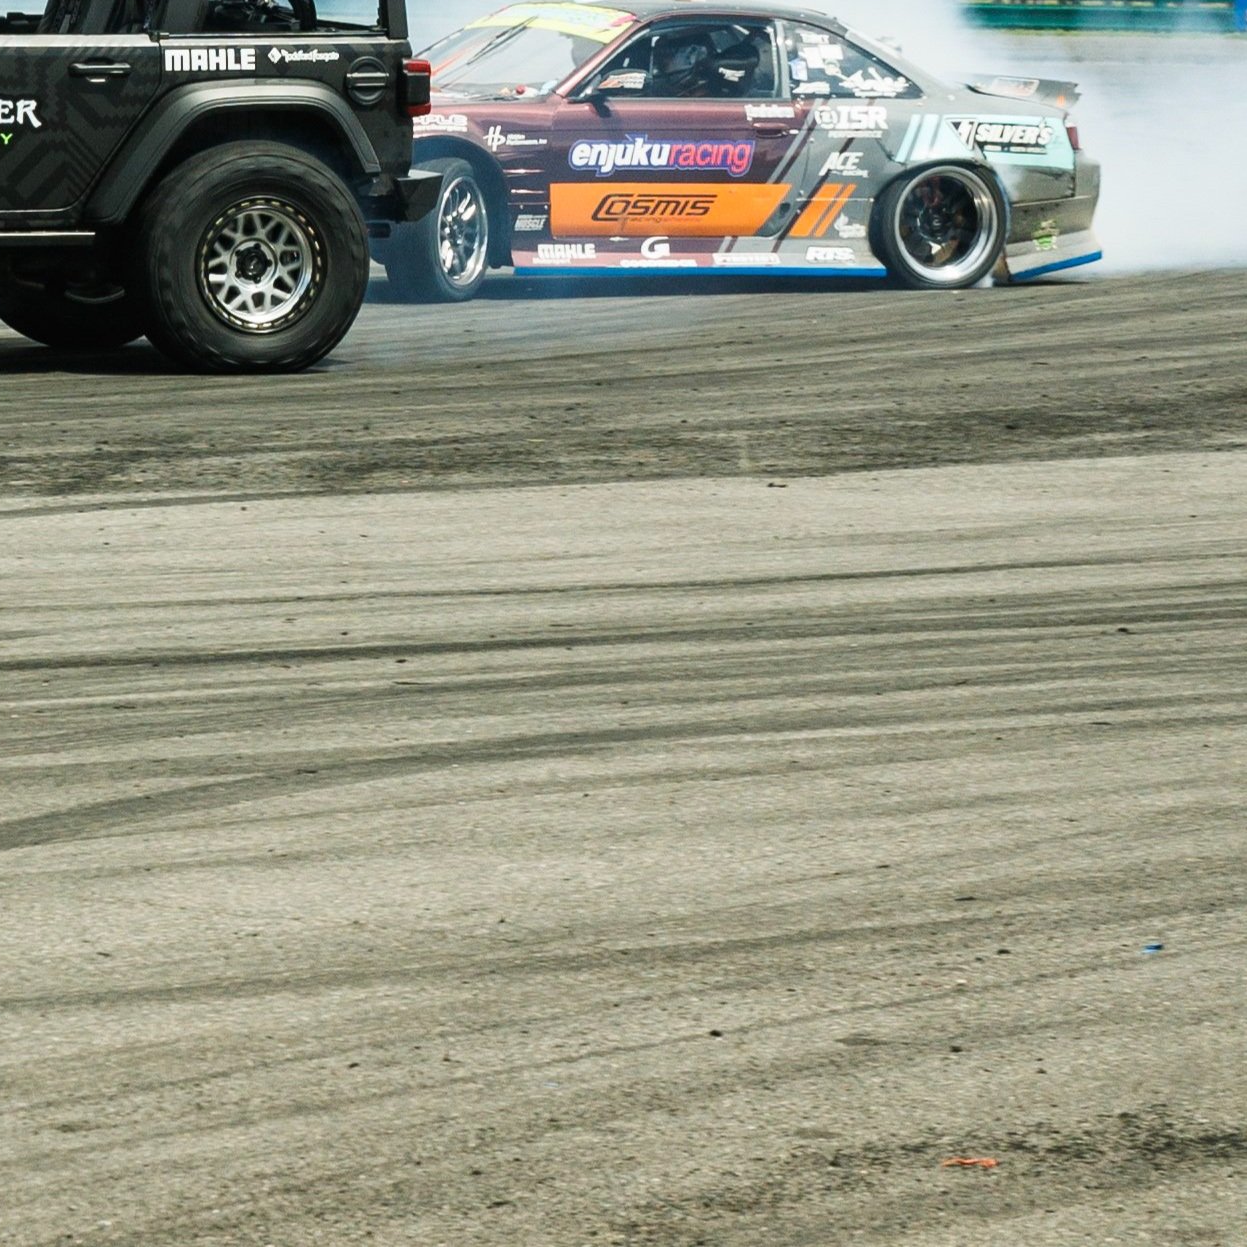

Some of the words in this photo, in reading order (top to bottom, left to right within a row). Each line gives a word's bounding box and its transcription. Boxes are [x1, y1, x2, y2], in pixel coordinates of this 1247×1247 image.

[165, 48, 256, 72] MAHLE
[837, 106, 889, 129] ISR
[818, 152, 864, 176] ACE
[537, 243, 596, 259] MAHLE
